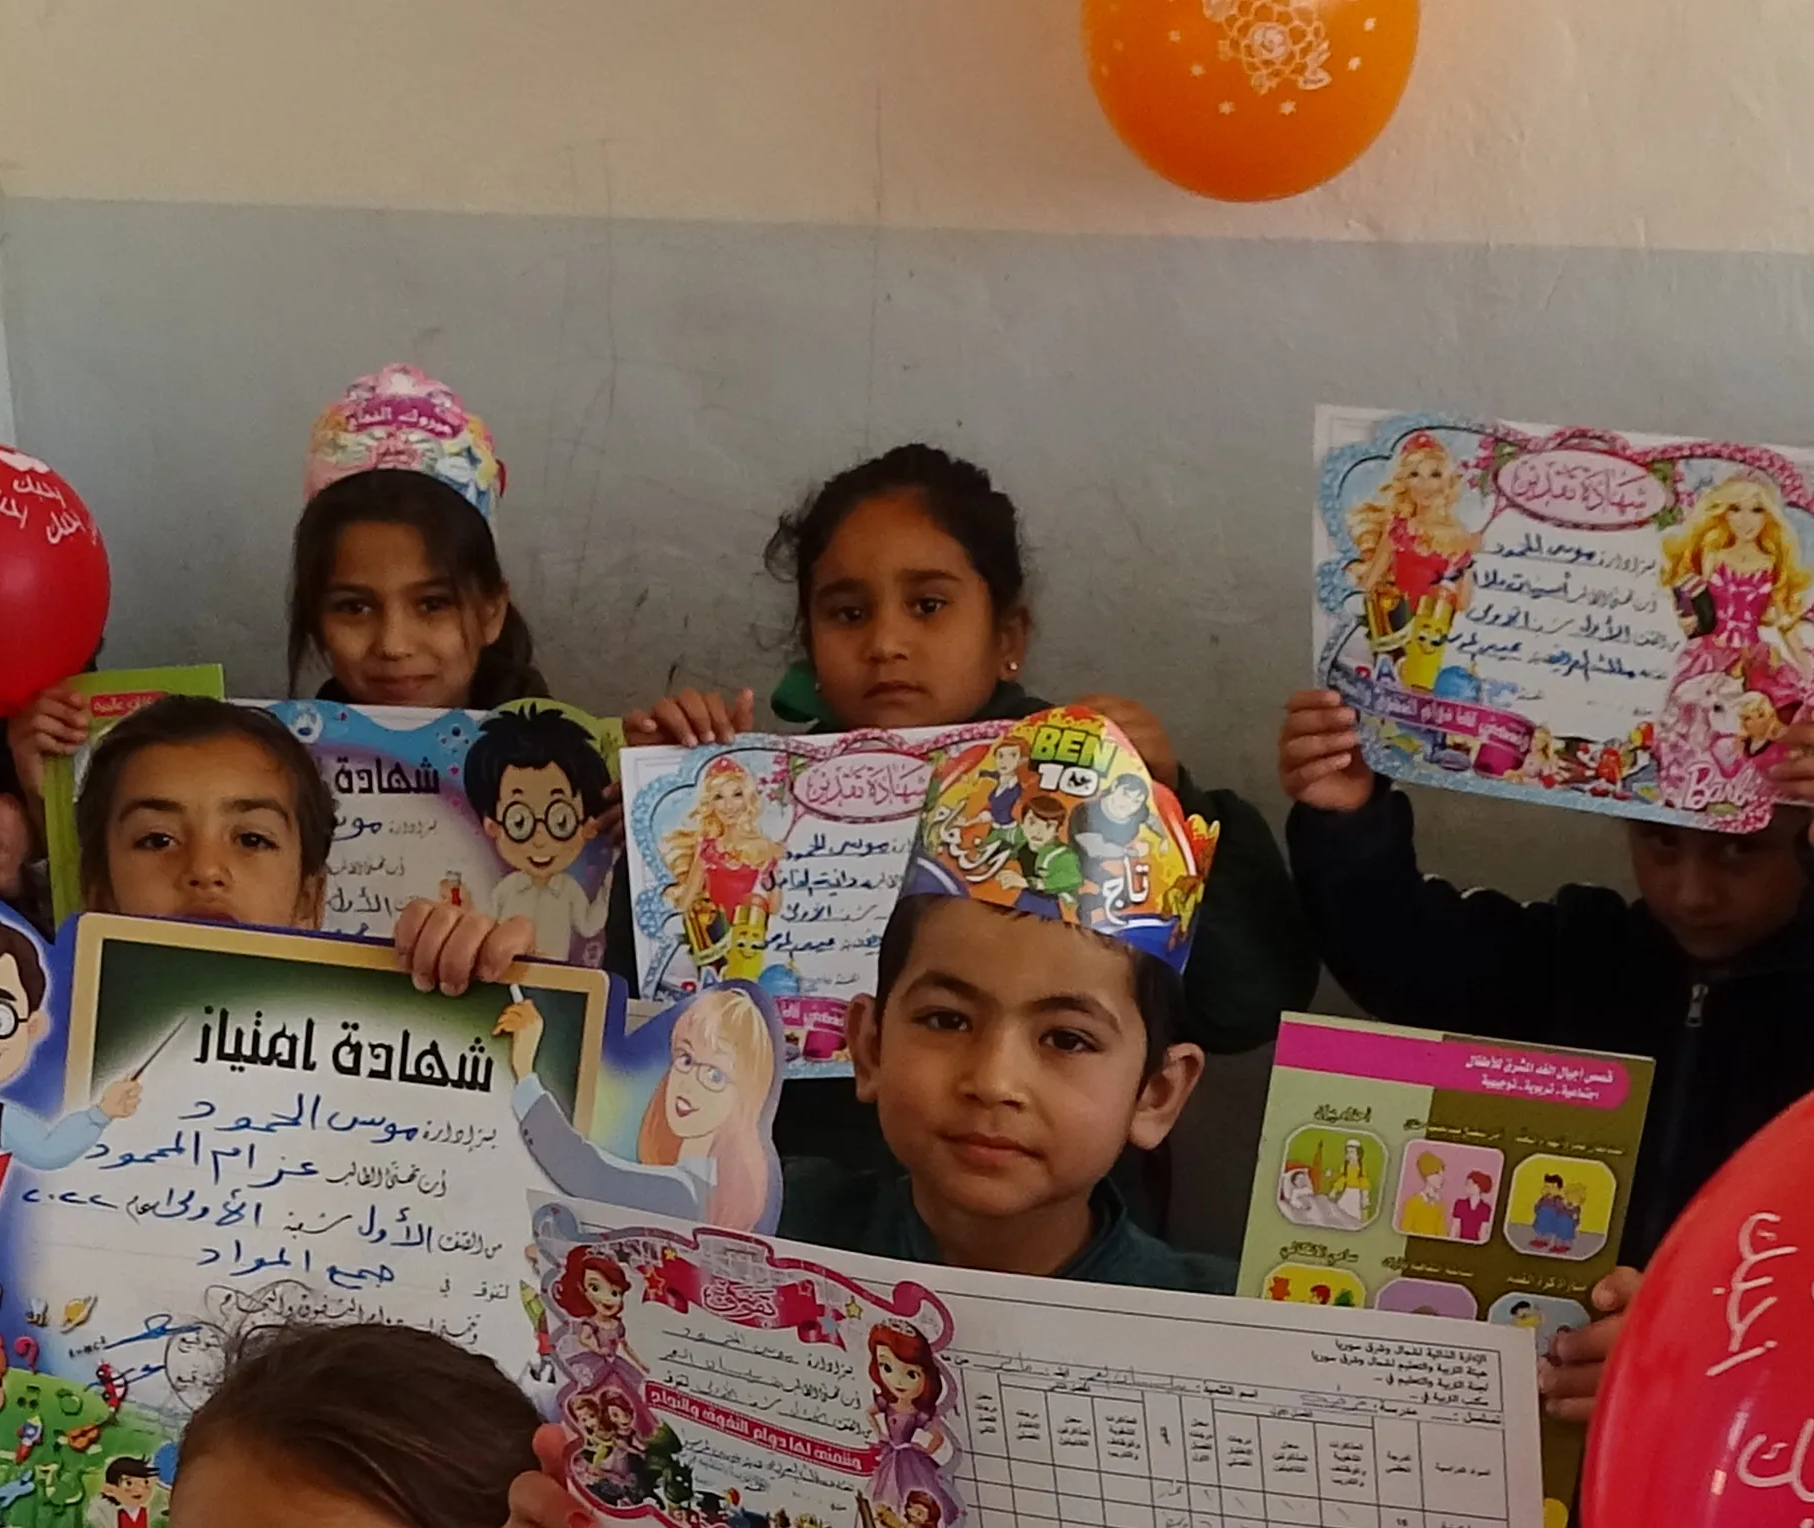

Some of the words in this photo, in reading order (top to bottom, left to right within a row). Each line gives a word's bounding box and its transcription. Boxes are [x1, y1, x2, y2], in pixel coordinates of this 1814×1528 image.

[335, 756, 441, 795] شهادة
[1031, 724, 1118, 778] BEN
[1036, 764, 1101, 798] 10
[1100, 854, 1151, 926] تاج
[193, 1005, 318, 1073] امتياز
[332, 1021, 494, 1093] شهادة
